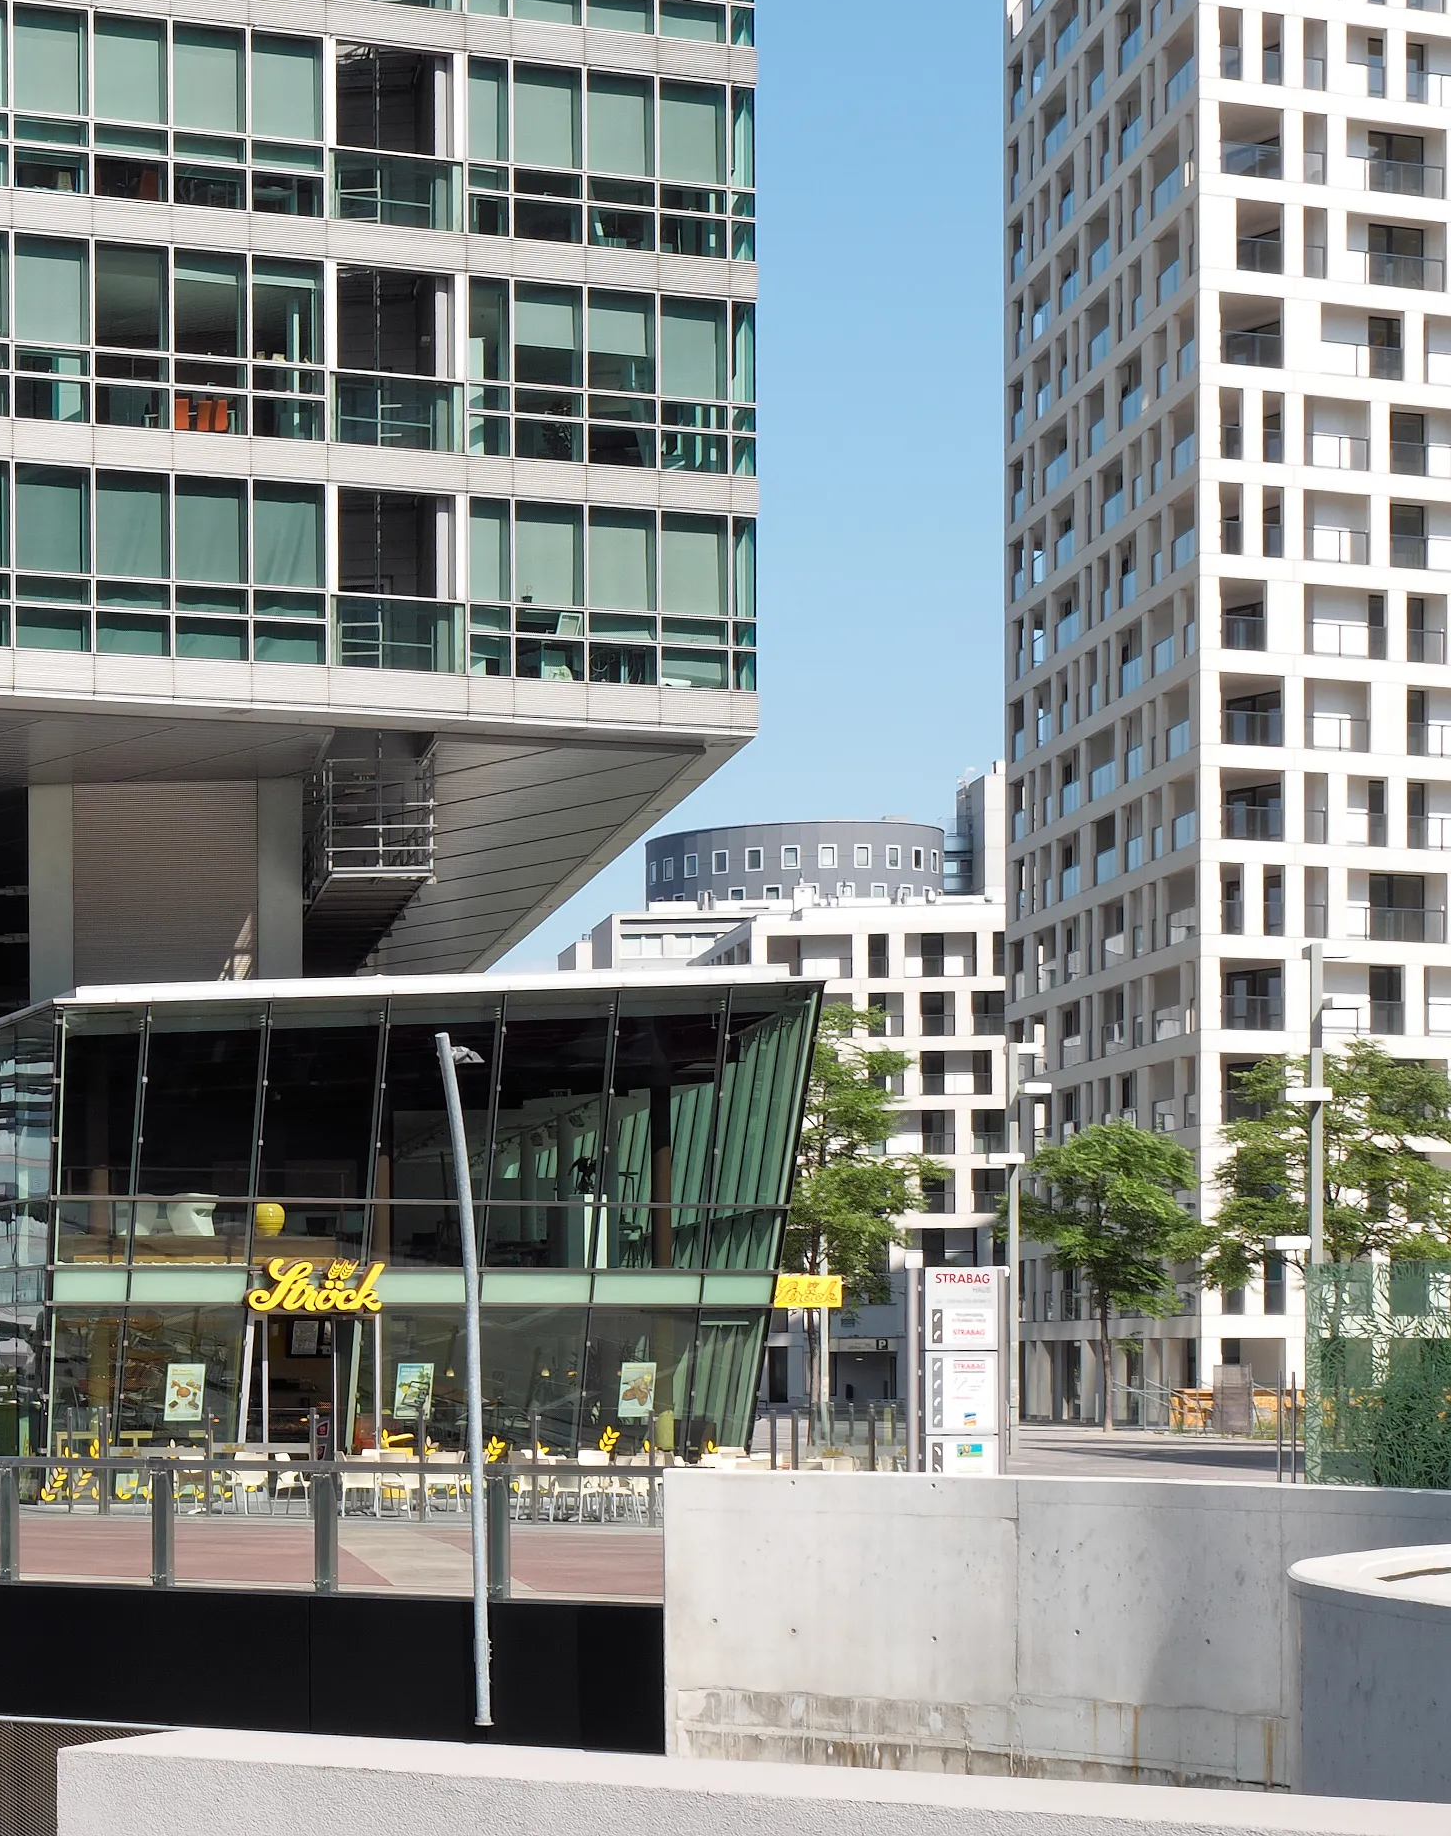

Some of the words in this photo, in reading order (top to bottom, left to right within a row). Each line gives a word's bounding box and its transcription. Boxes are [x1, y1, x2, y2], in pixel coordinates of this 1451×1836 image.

[935, 1273, 991, 1284] STRABAG
[245, 1257, 387, 1312] Ströck
[972, 1286, 991, 1294] HAUS
[775, 1279, 838, 1304] Ströck
[952, 1328, 986, 1336] STRABAG
